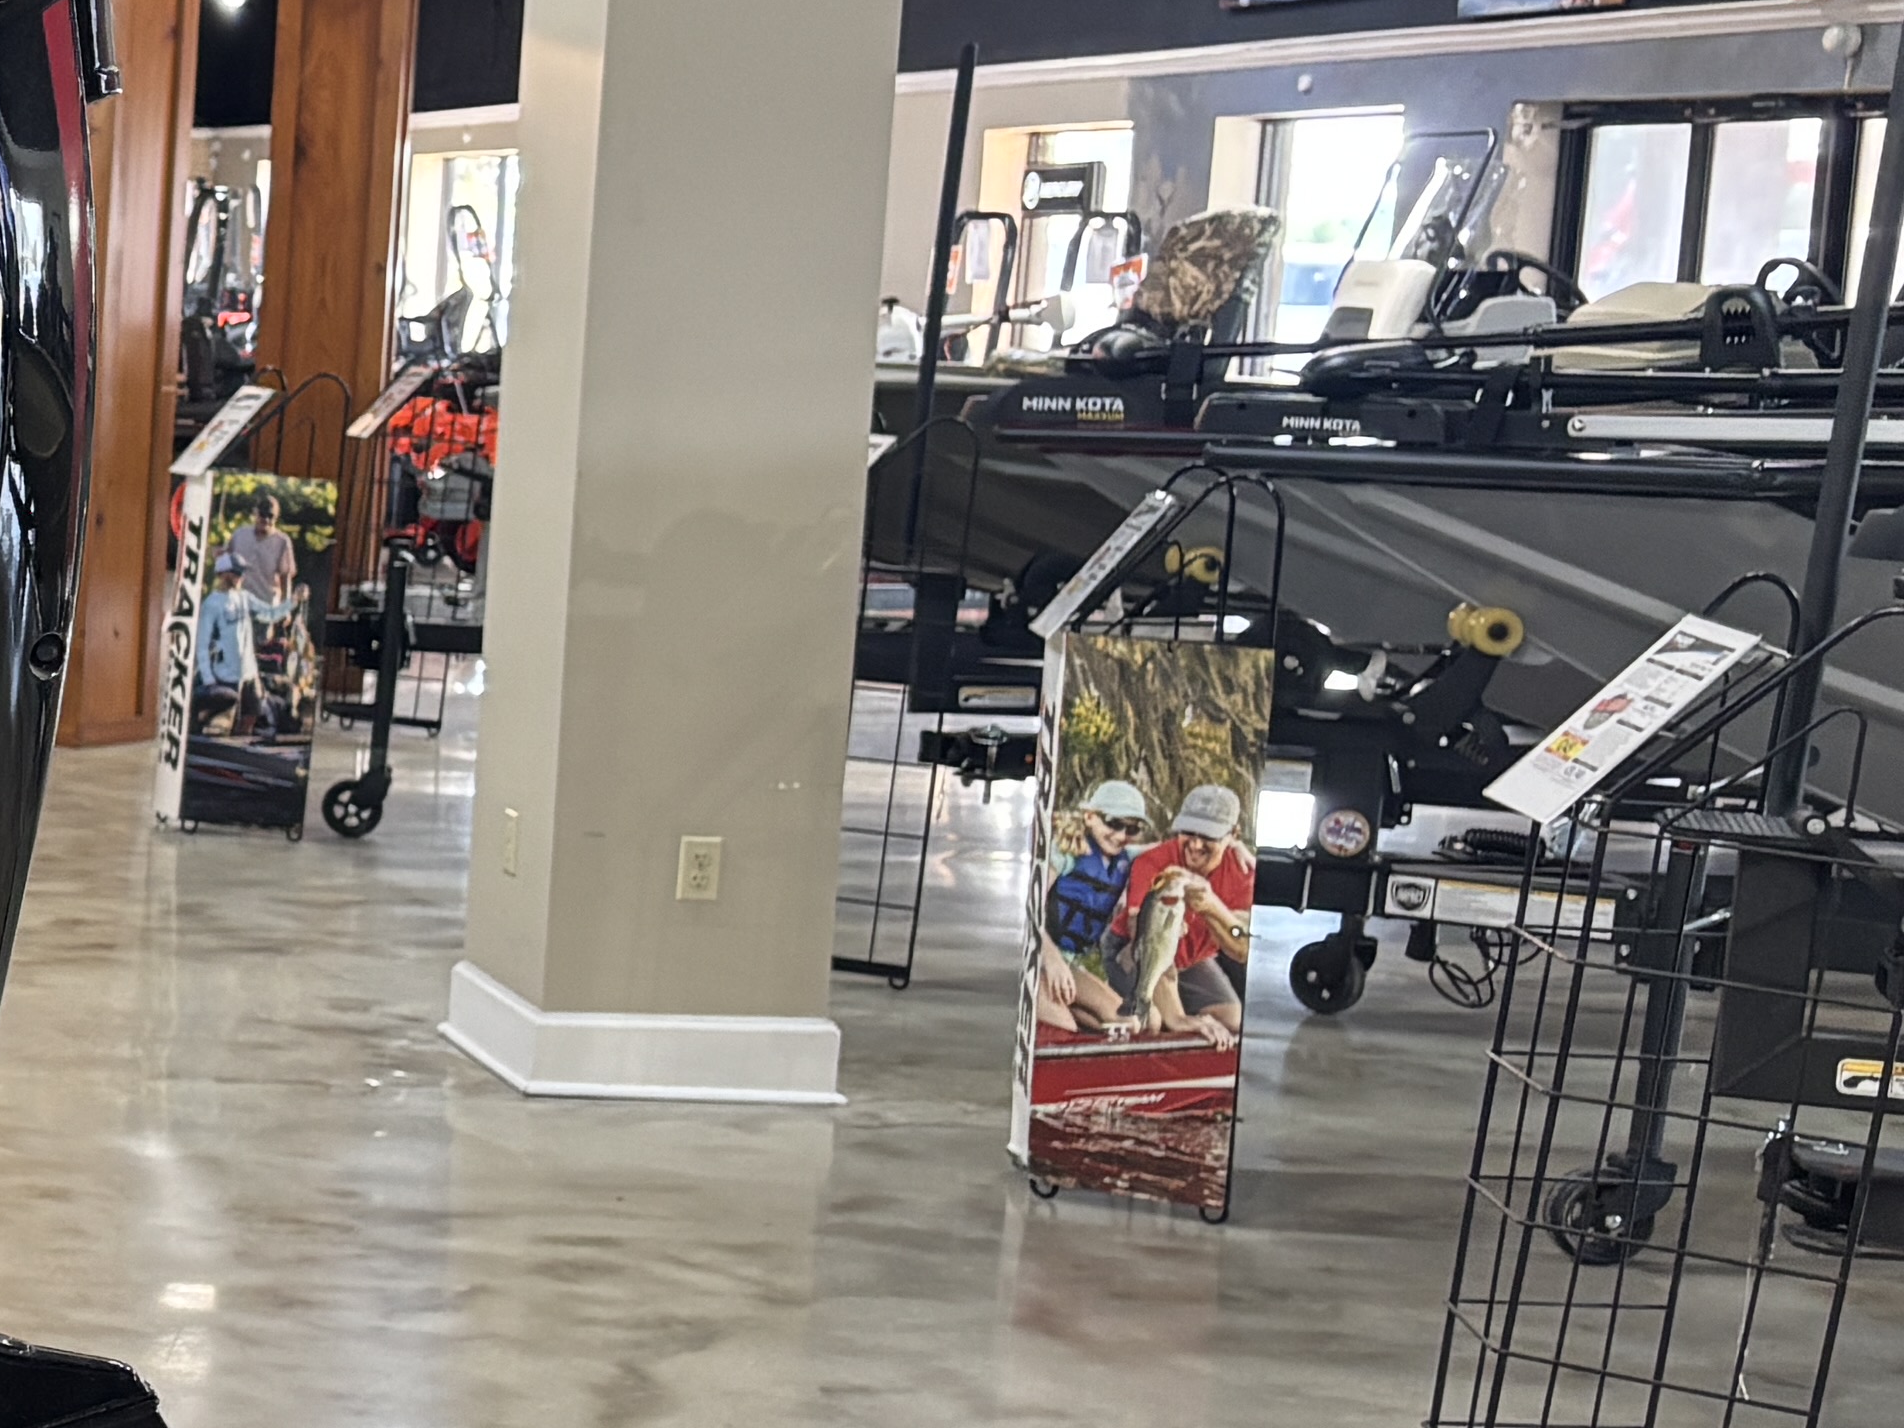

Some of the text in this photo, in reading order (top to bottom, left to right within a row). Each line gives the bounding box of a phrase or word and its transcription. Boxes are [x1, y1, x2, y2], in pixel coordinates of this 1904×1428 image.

[1021, 395, 1124, 412] MINN KOTA
[1282, 415, 1361, 432] MINN KOTA
[163, 515, 204, 771] TRACKER
[1017, 702, 1055, 1098] TRACKER
